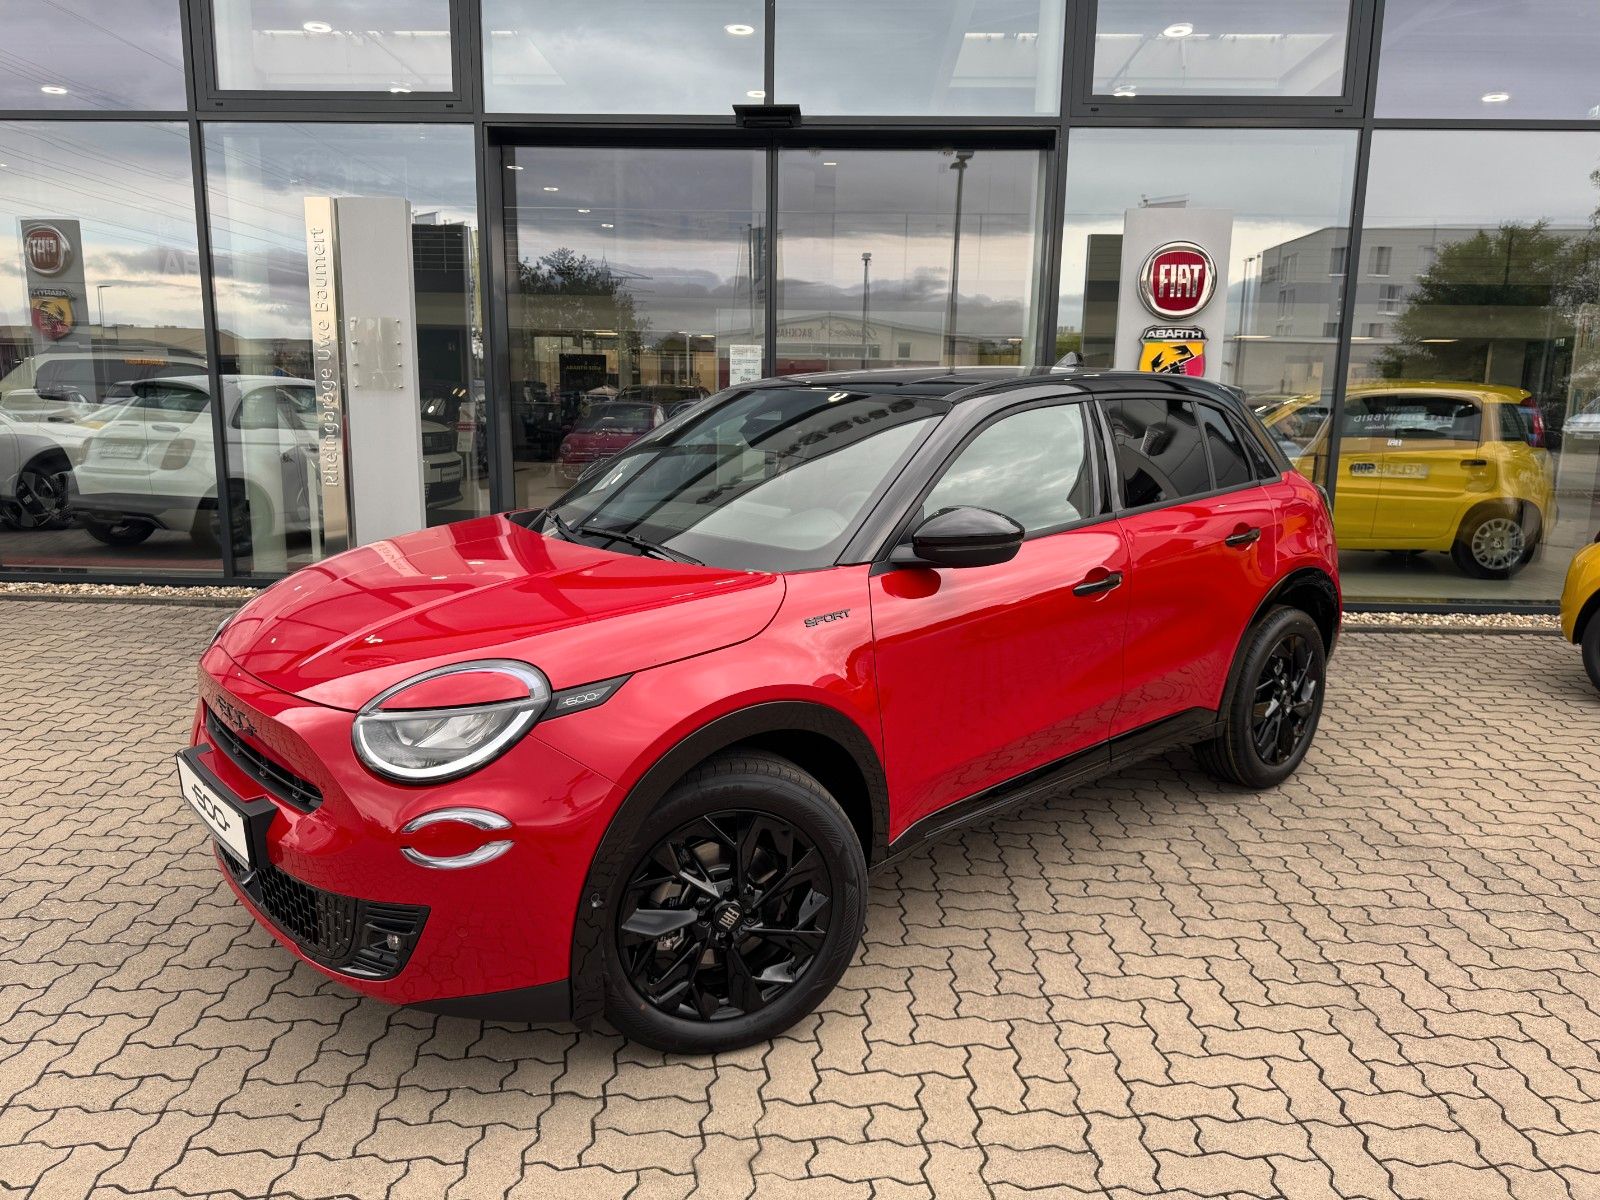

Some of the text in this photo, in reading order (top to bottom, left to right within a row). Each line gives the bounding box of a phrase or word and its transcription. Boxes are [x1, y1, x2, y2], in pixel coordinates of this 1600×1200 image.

[1158, 264, 1203, 298] FIAT
[1145, 329, 1202, 339] ABARTH
[310, 227, 340, 486] Rheingarage Uwe Baumert
[804, 608, 851, 628] SPORT
[718, 906, 740, 930] FIAT
